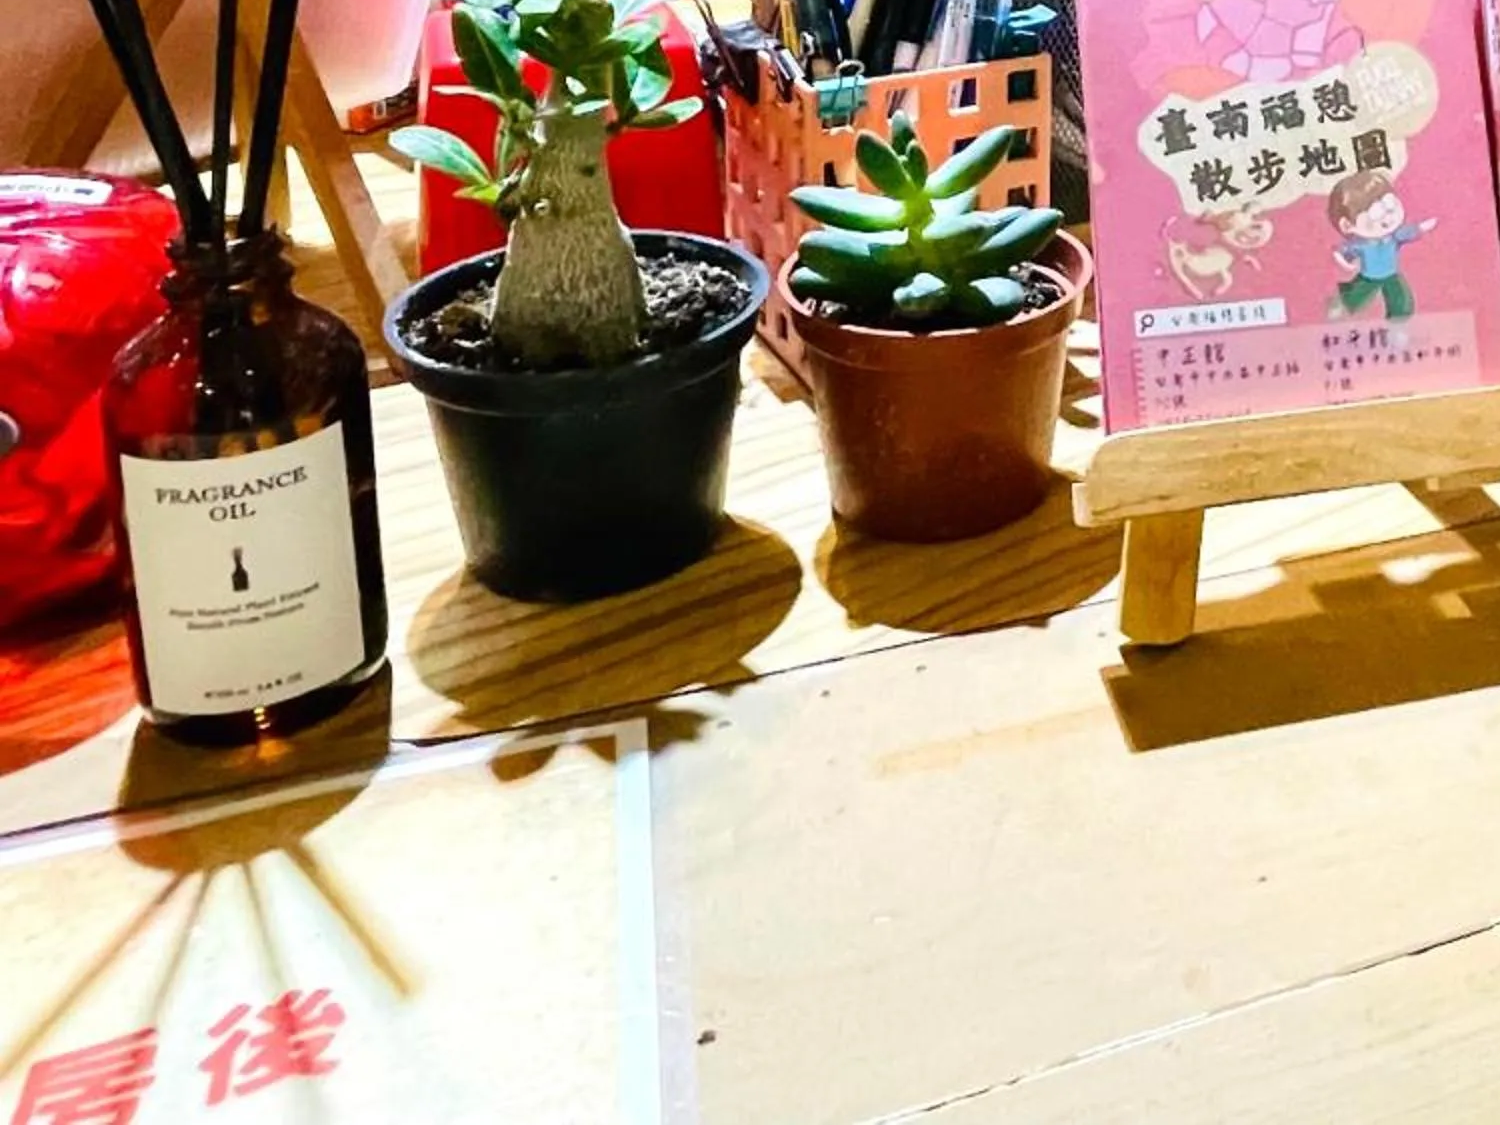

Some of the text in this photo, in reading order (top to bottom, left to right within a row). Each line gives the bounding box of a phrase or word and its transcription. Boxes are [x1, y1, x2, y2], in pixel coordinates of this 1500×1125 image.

[1155, 78, 1358, 156] 臺南福憩
[1190, 128, 1392, 202] 散步地圖
[155, 466, 308, 504] FRAGRANCE
[208, 502, 256, 523] OIL
